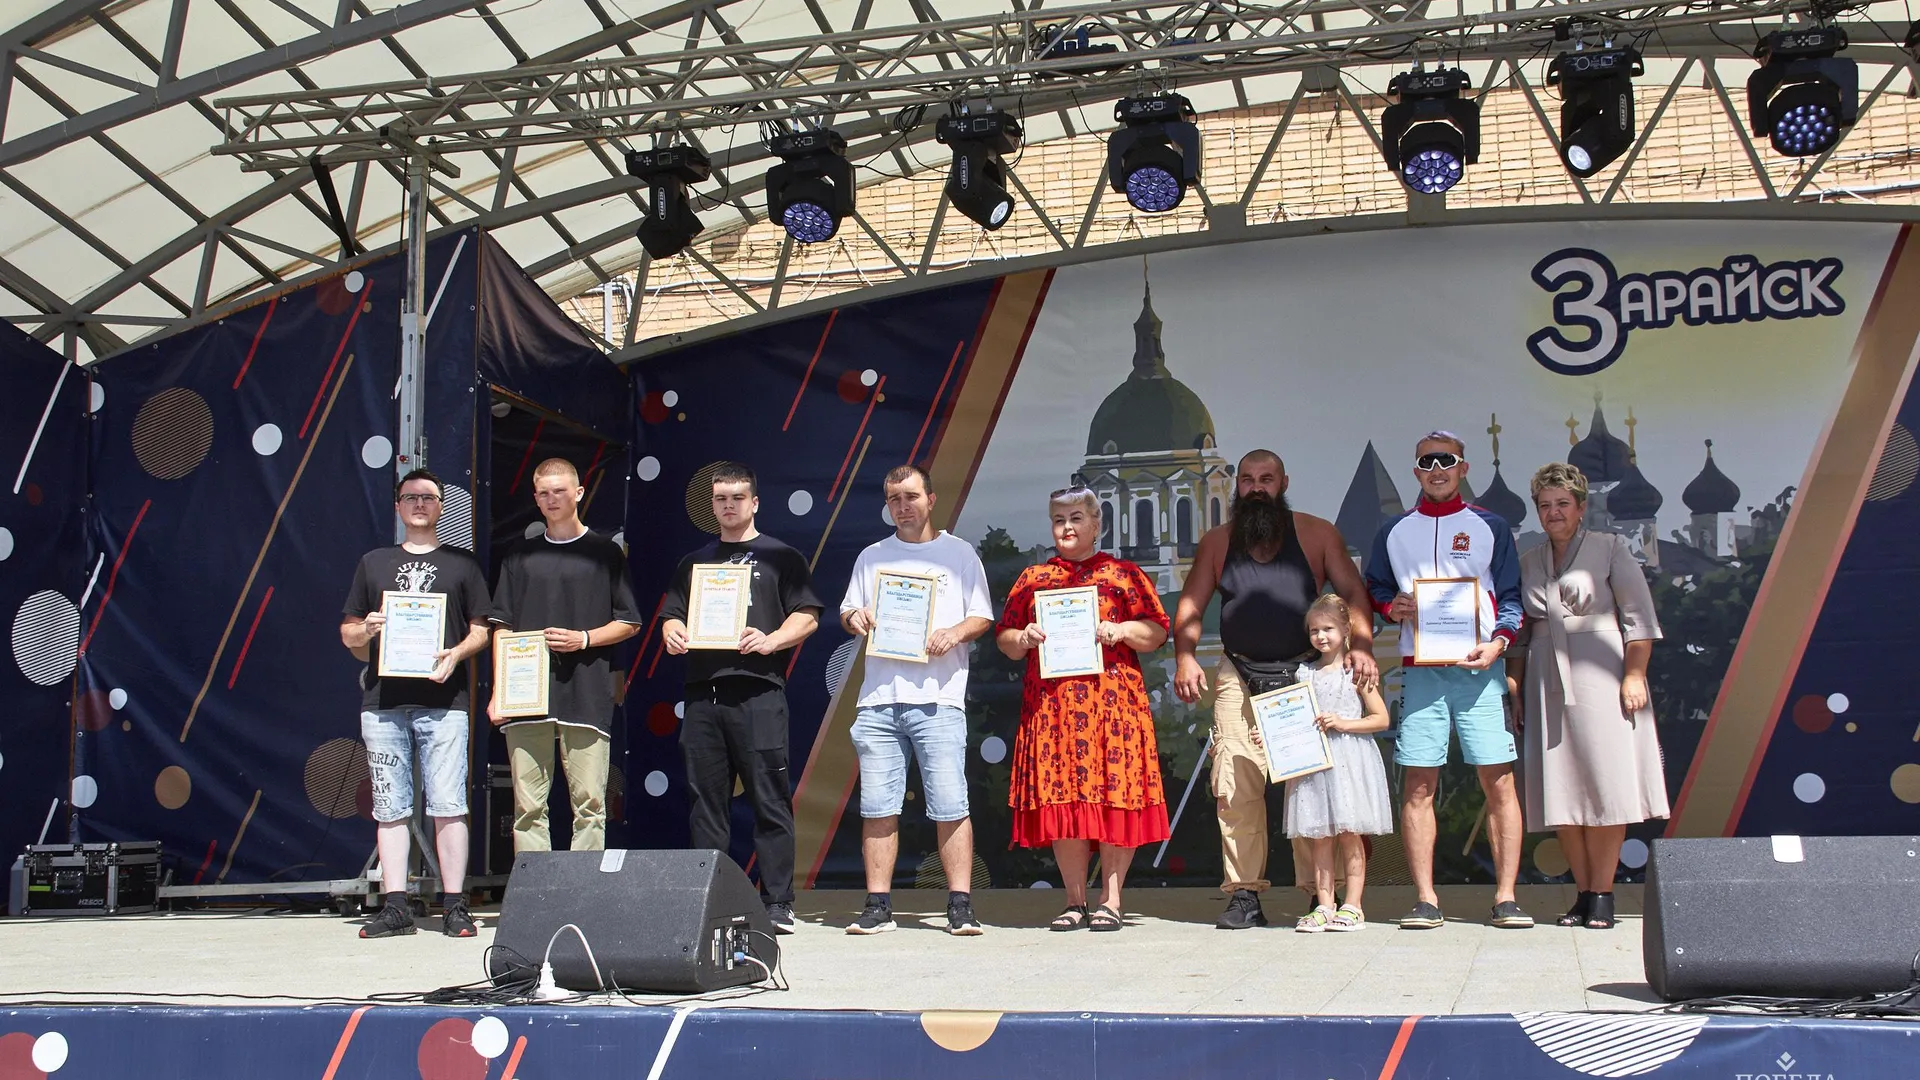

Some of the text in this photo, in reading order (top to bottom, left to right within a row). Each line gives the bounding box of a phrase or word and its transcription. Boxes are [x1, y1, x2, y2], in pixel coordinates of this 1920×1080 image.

[1532, 252, 1842, 370] ЗАРАЙСК
[397, 561, 438, 573] LET'S PLAY
